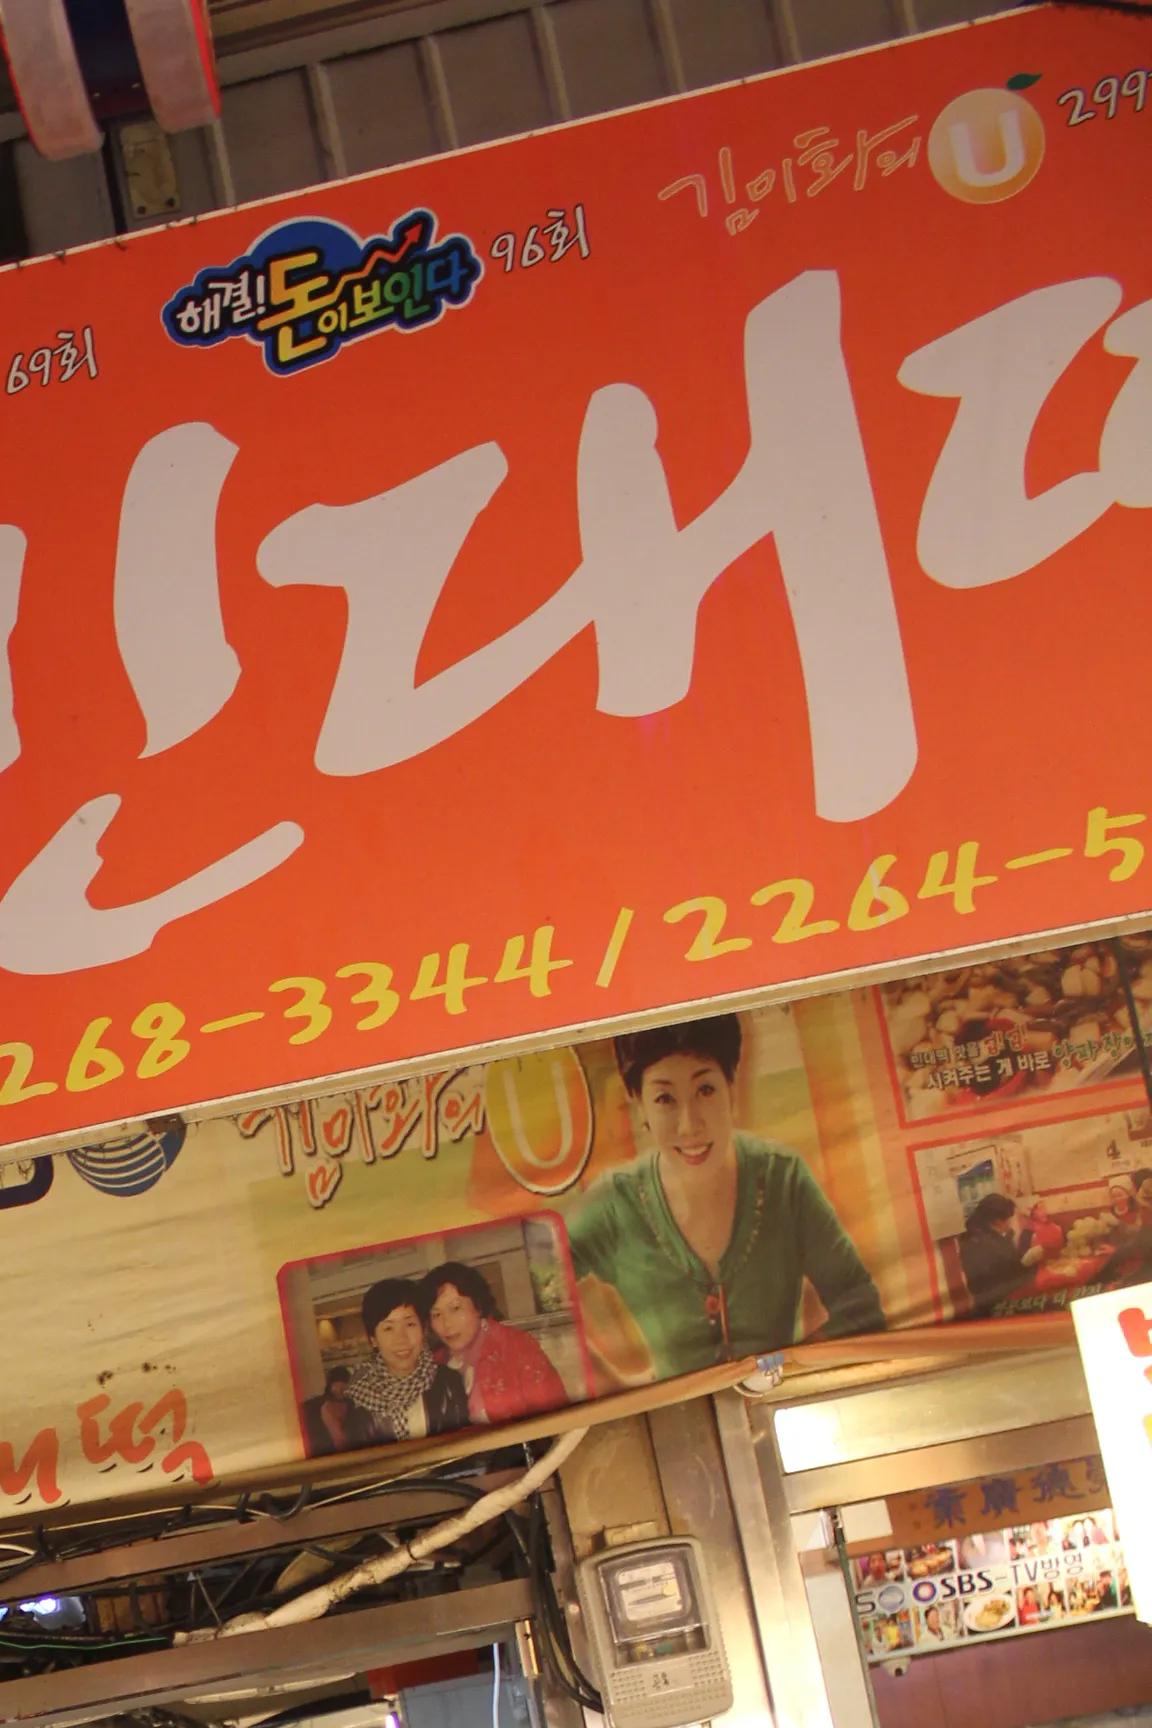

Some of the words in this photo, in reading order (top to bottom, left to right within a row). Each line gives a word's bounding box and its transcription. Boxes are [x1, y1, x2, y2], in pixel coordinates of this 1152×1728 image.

[657, 115, 922, 237] 김미화의
[949, 109, 1026, 188] U
[1056, 68, 1152, 128] 299
[176, 268, 266, 335] 해결!
[490, 204, 590, 273] 96회
[5, 325, 98, 395] 69회
[663, 806, 1147, 963] 2264-5
[928, 1065, 992, 1090] 시켜주는
[1017, 1050, 1051, 1072] 바로
